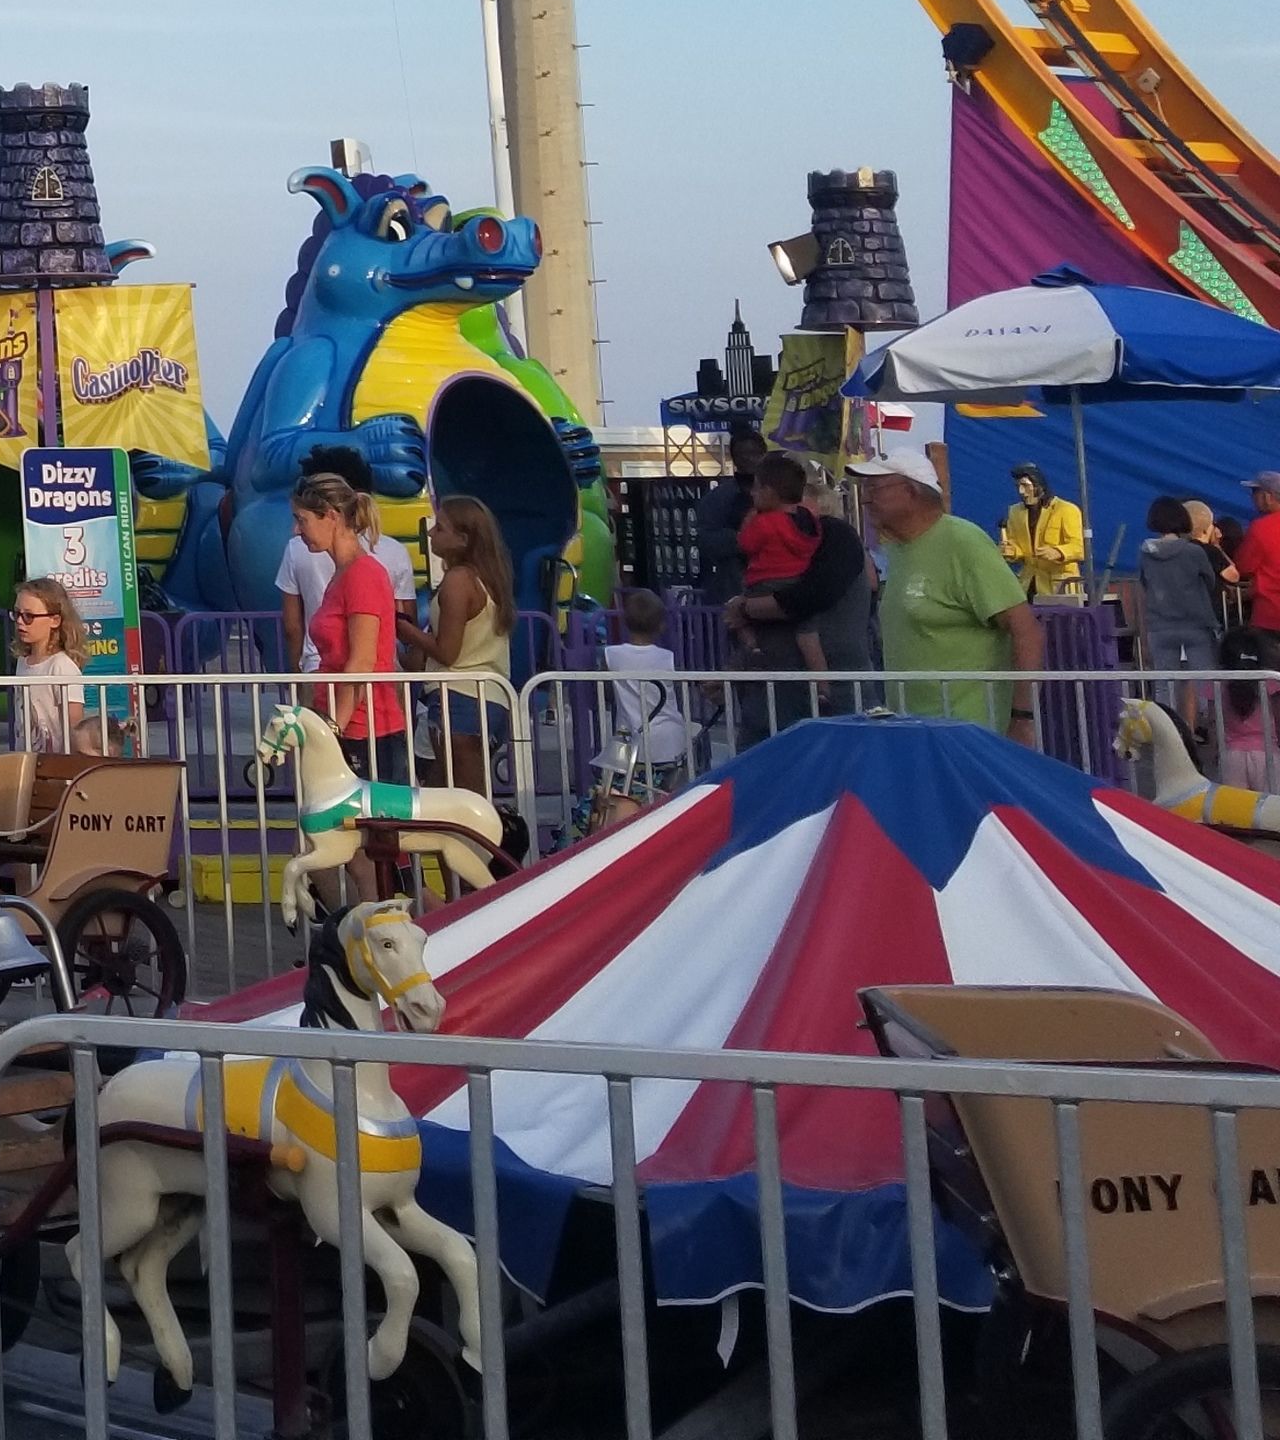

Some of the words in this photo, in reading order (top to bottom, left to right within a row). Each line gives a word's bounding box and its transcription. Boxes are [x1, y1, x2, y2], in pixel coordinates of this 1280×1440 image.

[42, 461, 96, 488] Dizzy
[29, 488, 112, 512] Dragons
[63, 527, 86, 565] 3
[122, 531, 131, 559] CAN
[124, 562, 133, 590] YOU
[69, 813, 112, 832] PONY
[125, 815, 166, 832] CART
[1056, 1173, 1183, 1214] ONY
